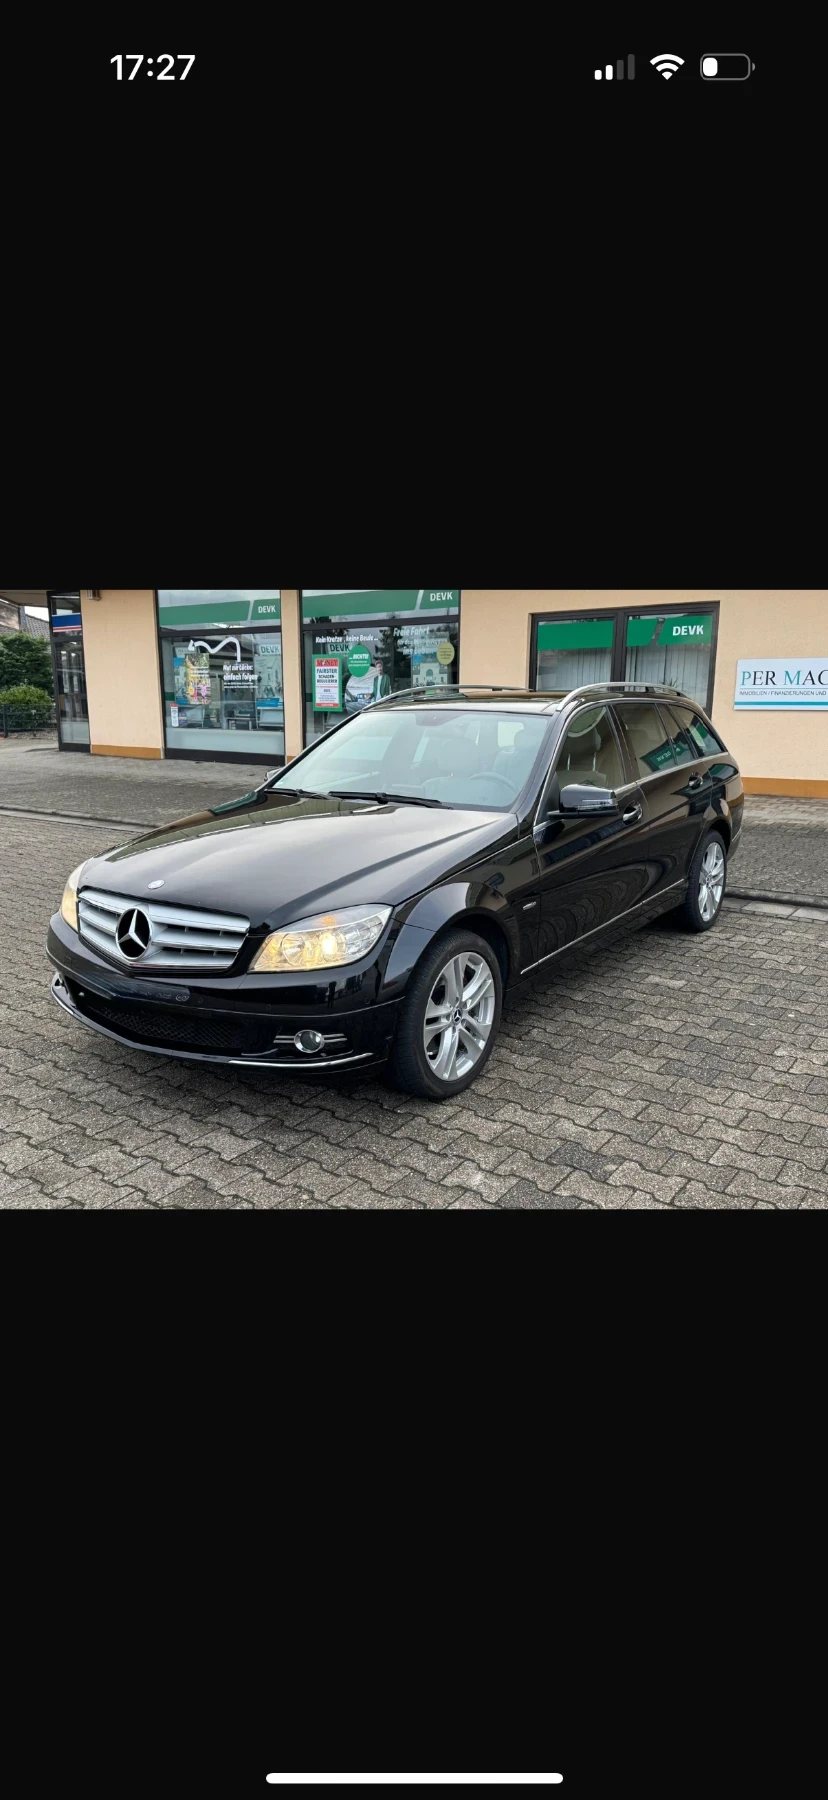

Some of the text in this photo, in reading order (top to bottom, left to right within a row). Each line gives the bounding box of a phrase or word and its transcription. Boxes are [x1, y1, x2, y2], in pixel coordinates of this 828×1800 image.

[429, 591, 453, 602] DEVK
[258, 605, 276, 614] DEVK
[672, 625, 704, 636] DEVK
[260, 645, 280, 654] DEVK
[329, 644, 350, 652] DEVK
[741, 670, 777, 686] PER
